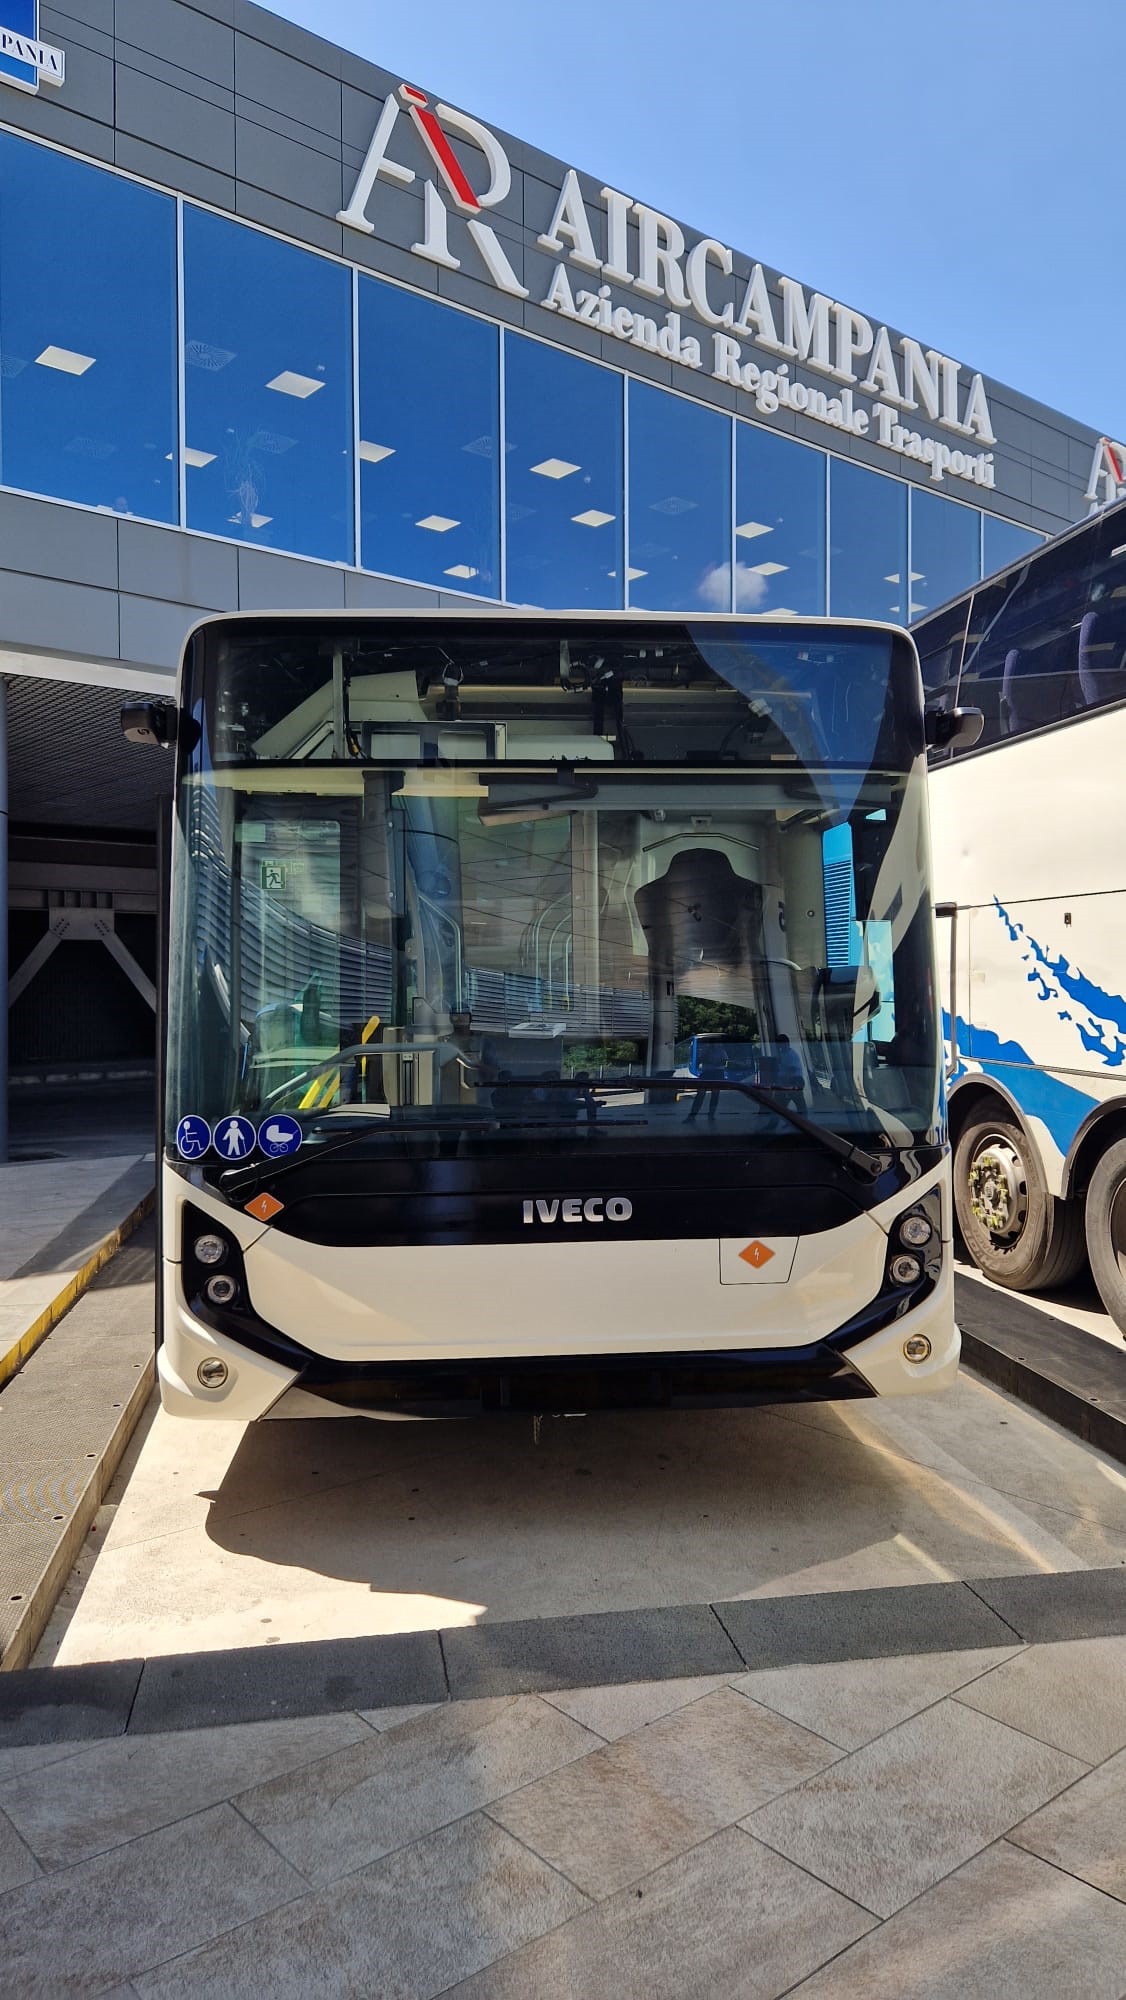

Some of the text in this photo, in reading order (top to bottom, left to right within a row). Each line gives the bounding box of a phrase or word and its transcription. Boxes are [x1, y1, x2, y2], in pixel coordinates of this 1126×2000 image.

[537, 169, 997, 445] AIRCAMPANIA
[540, 262, 996, 489] Azienda Regionale Trasporti
[523, 1197, 632, 1223] IVECO
